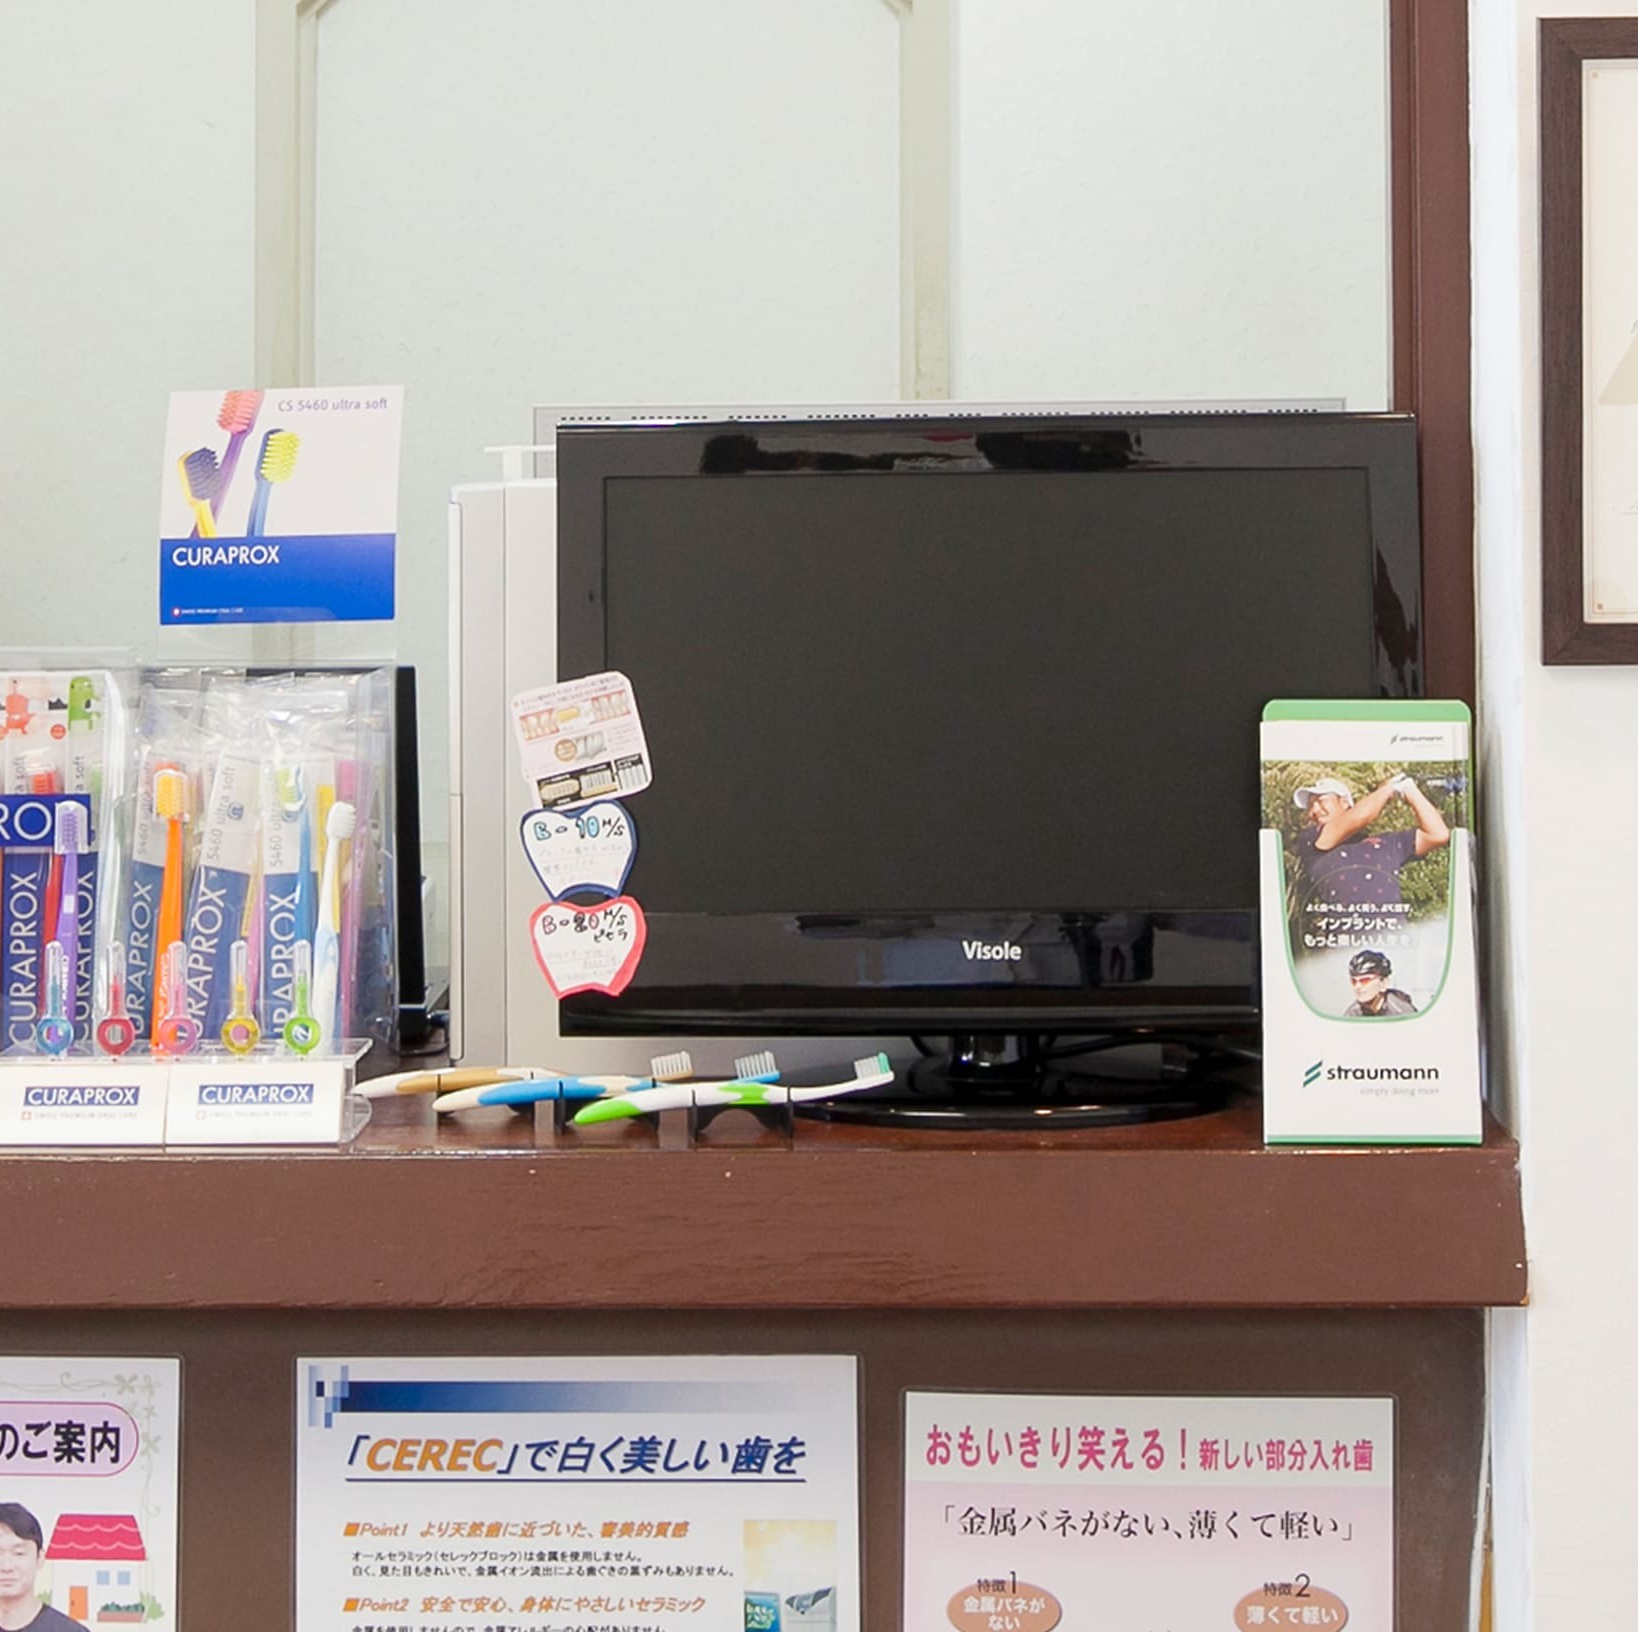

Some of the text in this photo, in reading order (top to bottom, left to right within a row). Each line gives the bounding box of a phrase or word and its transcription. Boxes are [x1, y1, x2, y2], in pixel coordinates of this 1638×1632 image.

[278, 398, 387, 412] CS 5460 ultra soft
[172, 545, 280, 566] CURAPROX
[9, 871, 38, 1048] CURAPROX
[963, 941, 1021, 960] Visole
[1327, 1066, 1439, 1081] straumann
[26, 1087, 137, 1105] CURAPROX
[201, 1085, 311, 1103] CURAPROX
[346, 1434, 806, 1476] 「CEREC」で白く美しい歯を
[926, 1424, 1374, 1472] おもいきり笑える！ 新しい部分入れ歯
[941, 1505, 1356, 1542] 「金属バネがない、薄くて軽い」
[963, 1595, 1045, 1614] 金属バネが
[988, 1614, 1021, 1631] ない
[1247, 1605, 1339, 1625] 薄くて軽い
